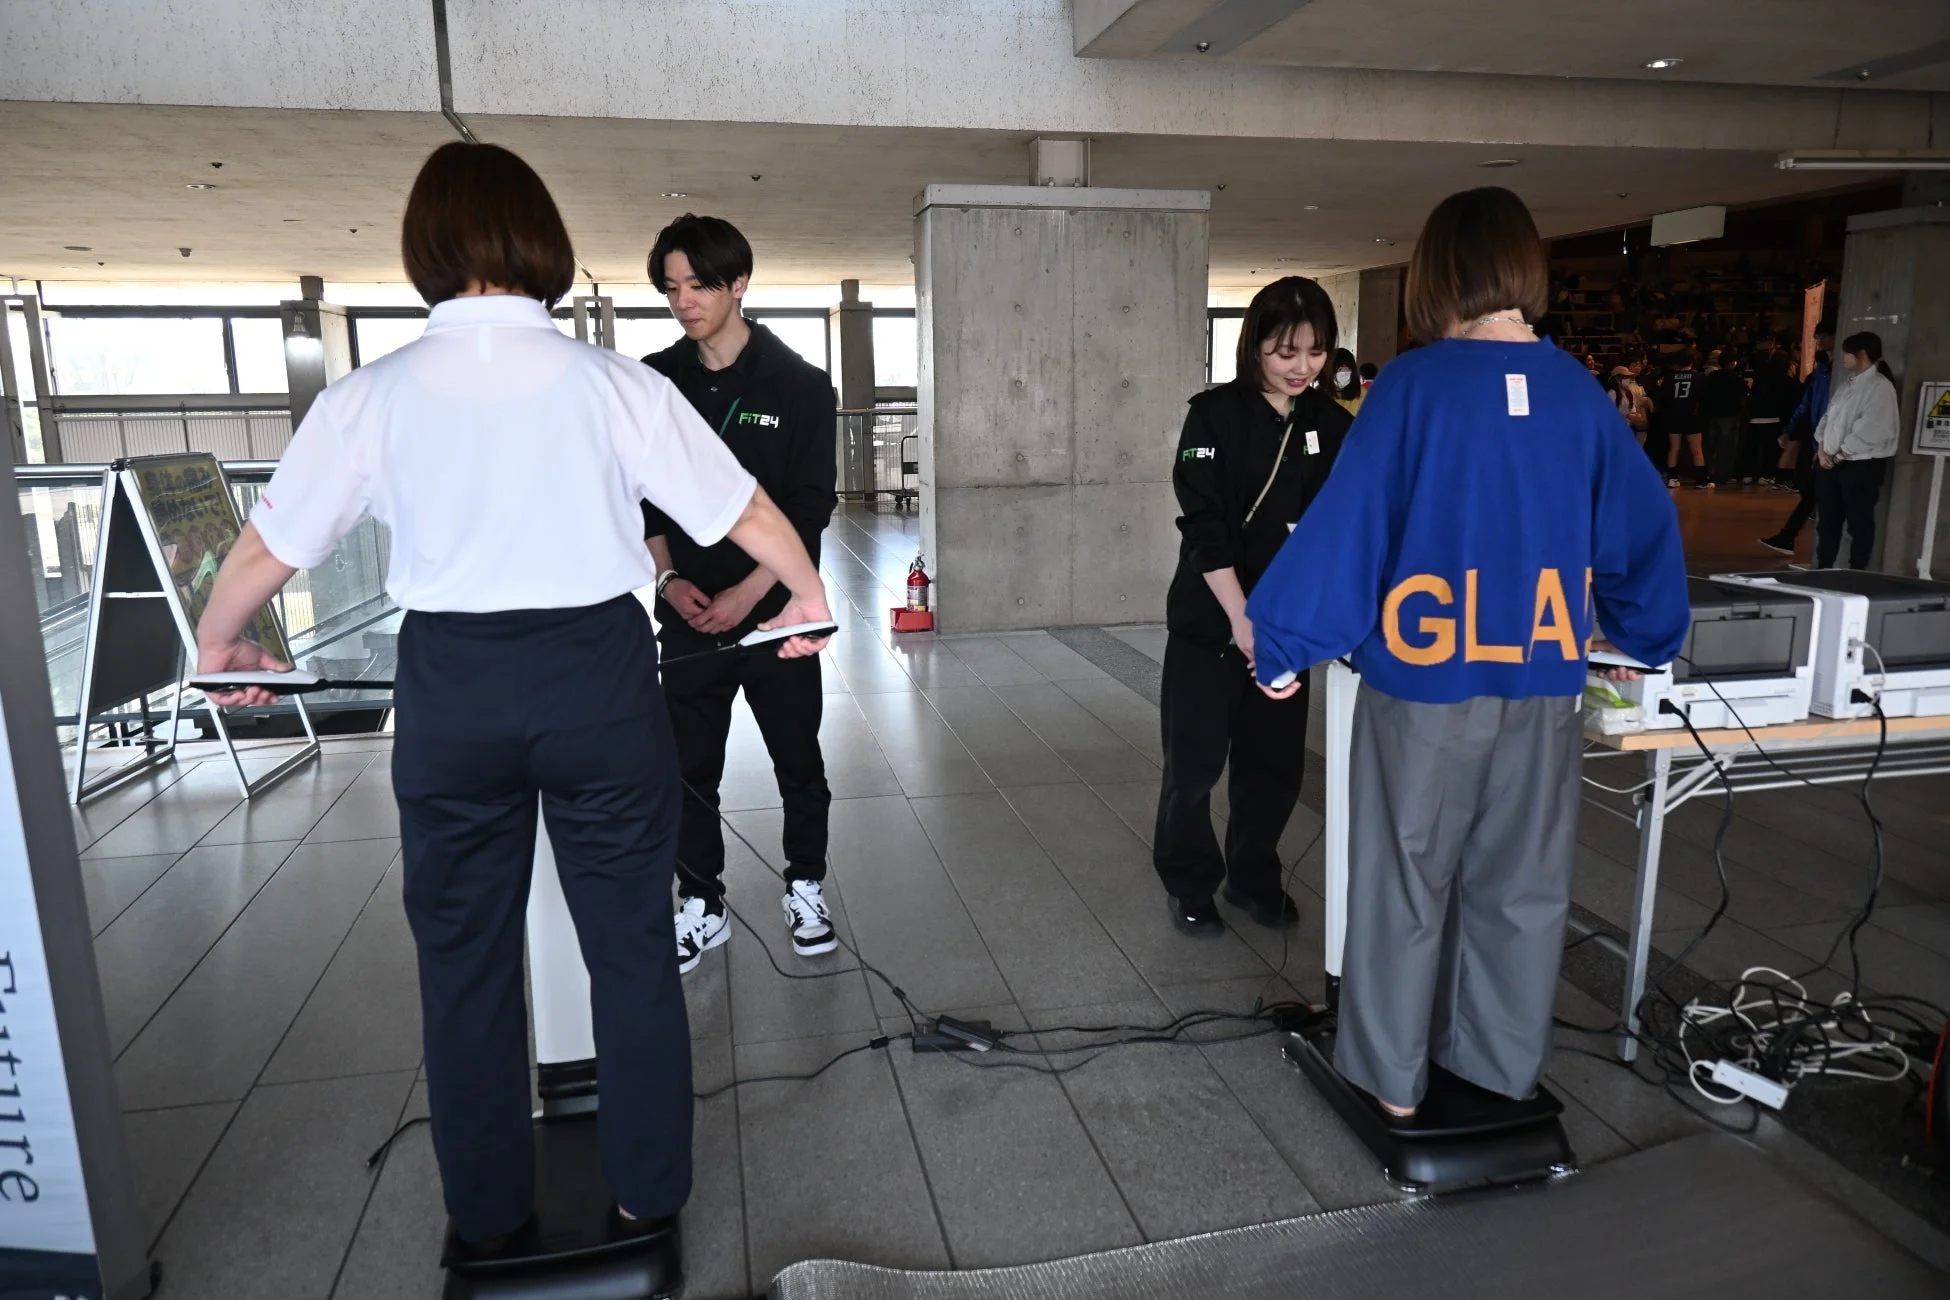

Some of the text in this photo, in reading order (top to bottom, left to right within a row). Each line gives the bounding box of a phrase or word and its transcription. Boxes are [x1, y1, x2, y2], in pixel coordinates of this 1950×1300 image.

[1674, 381, 1691, 398] 13
[1382, 567, 1593, 667] GLA
[0, 950, 41, 1203] ure
